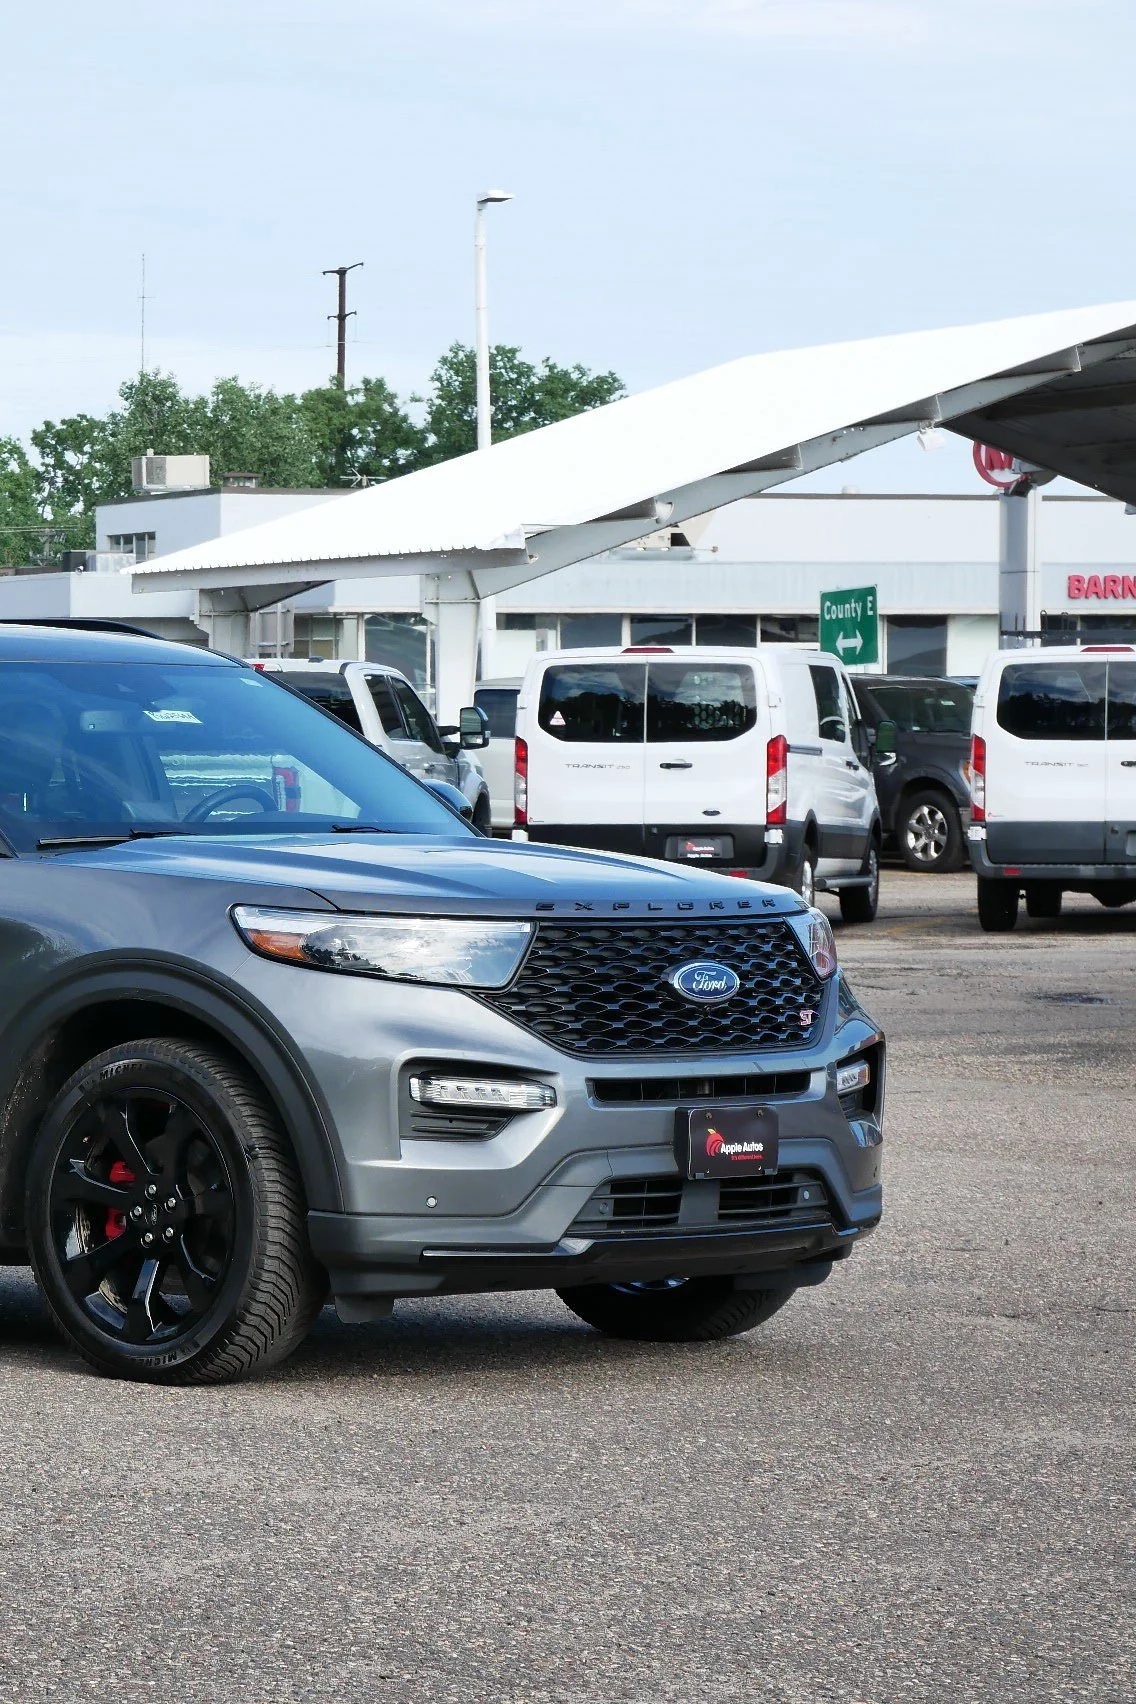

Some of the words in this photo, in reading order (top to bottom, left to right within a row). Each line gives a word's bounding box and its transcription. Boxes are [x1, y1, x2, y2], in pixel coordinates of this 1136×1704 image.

[824, 598, 862, 622] County
[867, 596, 874, 616] E
[535, 899, 777, 911] EXPLORER
[692, 970, 728, 993] Ford
[800, 1009, 813, 1026] ST
[721, 1142, 743, 1155] Apple
[743, 1141, 764, 1152] Autos
